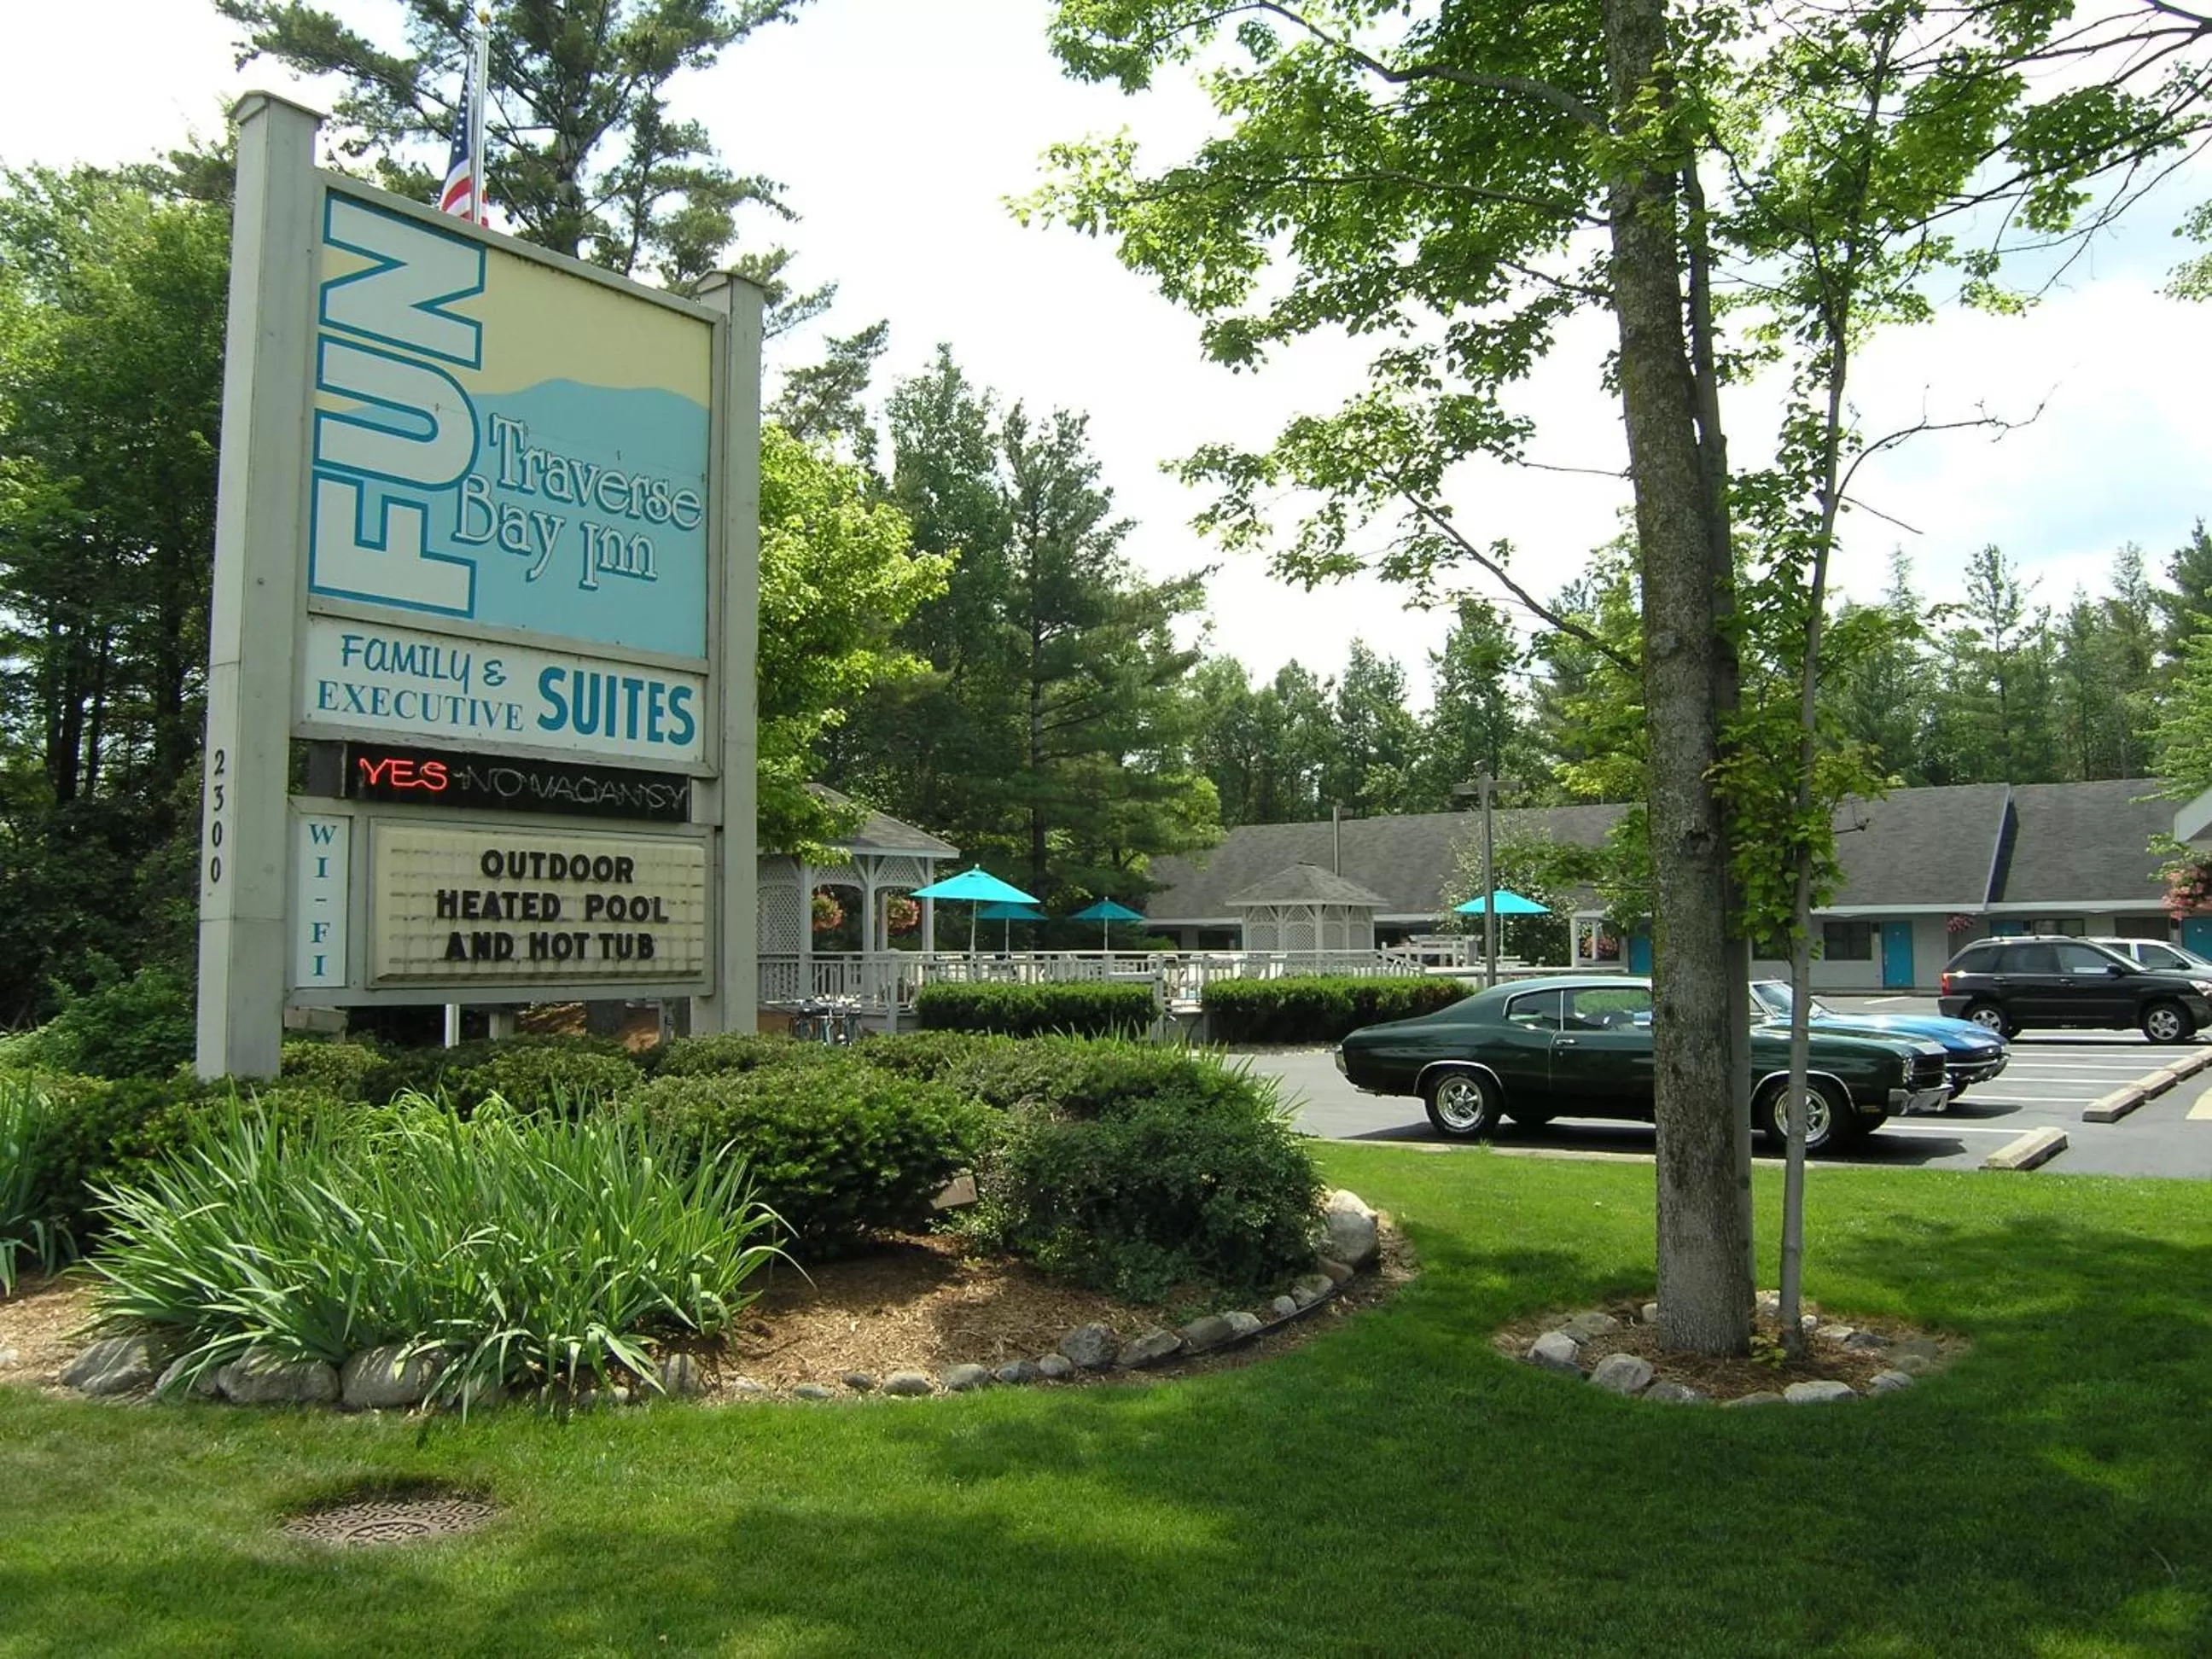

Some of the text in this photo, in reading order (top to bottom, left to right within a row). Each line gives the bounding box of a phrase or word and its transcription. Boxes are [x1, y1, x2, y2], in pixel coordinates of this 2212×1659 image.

[308, 189, 487, 620] FUN
[488, 413, 702, 531] Traverse
[451, 473, 658, 591] Bay Inn
[483, 659, 508, 687] &
[317, 680, 525, 731] EXECUTIVE
[536, 666, 696, 747] SUITES
[358, 757, 450, 791] YES
[463, 765, 524, 797] NO
[210, 748, 225, 884] 2300
[480, 849, 635, 883] OUTDOOR
[435, 889, 670, 923] HEATED POOL
[444, 931, 655, 961] AND HOT TUB
